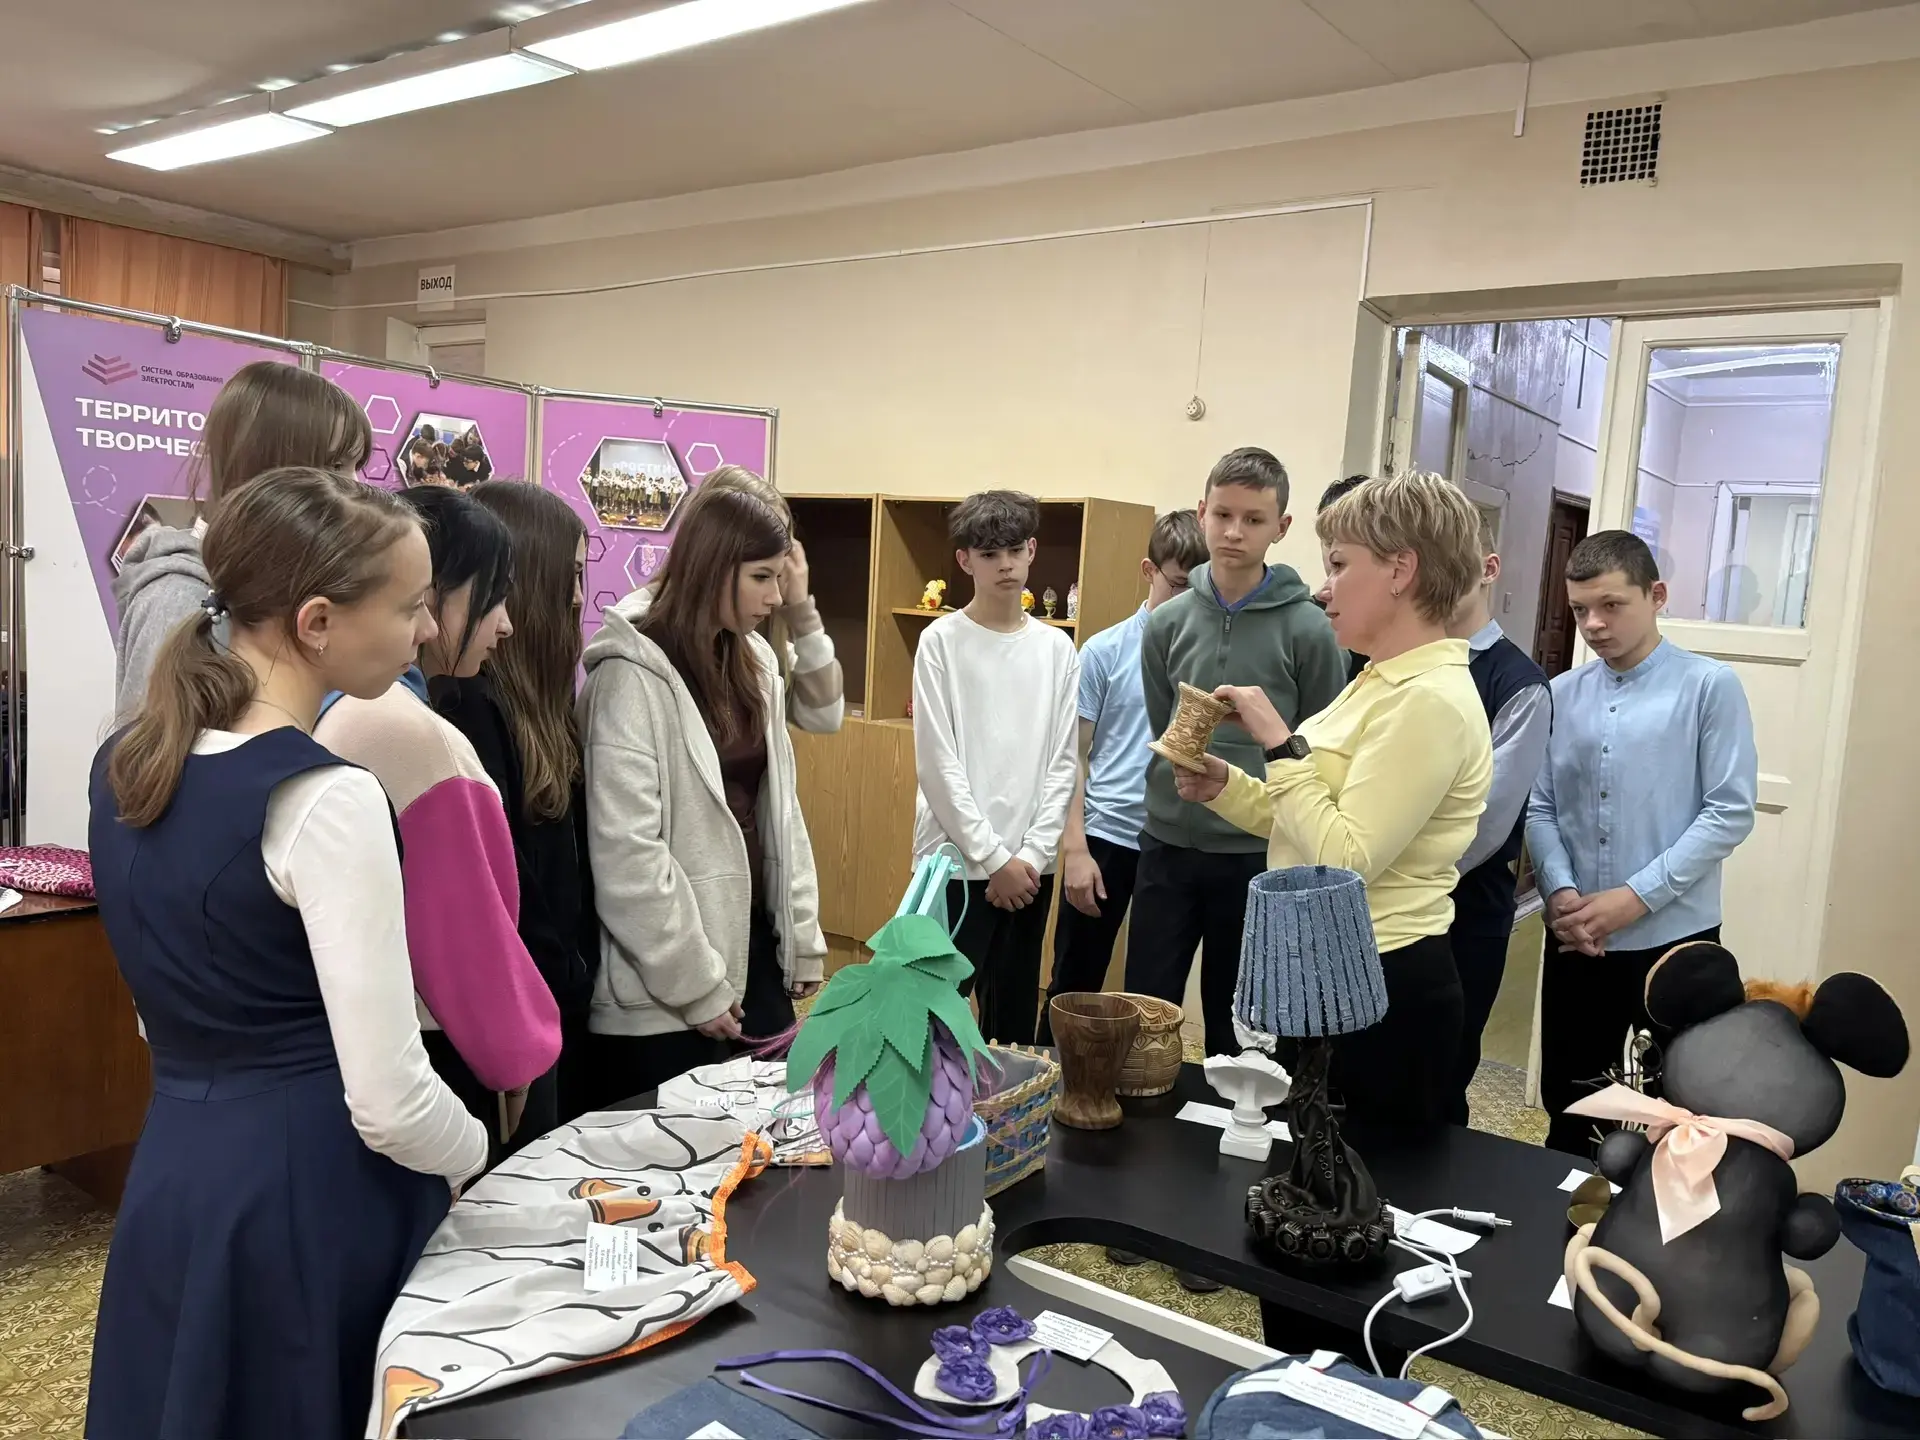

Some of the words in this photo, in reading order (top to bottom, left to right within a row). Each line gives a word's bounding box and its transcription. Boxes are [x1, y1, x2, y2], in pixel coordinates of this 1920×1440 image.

[420, 276, 452, 290] ВЫХОД
[141, 365, 172, 376] СИСТЕМА
[176, 370, 223, 384] ОБРАЗОВАНИЯ
[141, 375, 195, 389] ЭЛЕКТРОСТАЛИ
[75, 397, 206, 431] ТЕРРИТО
